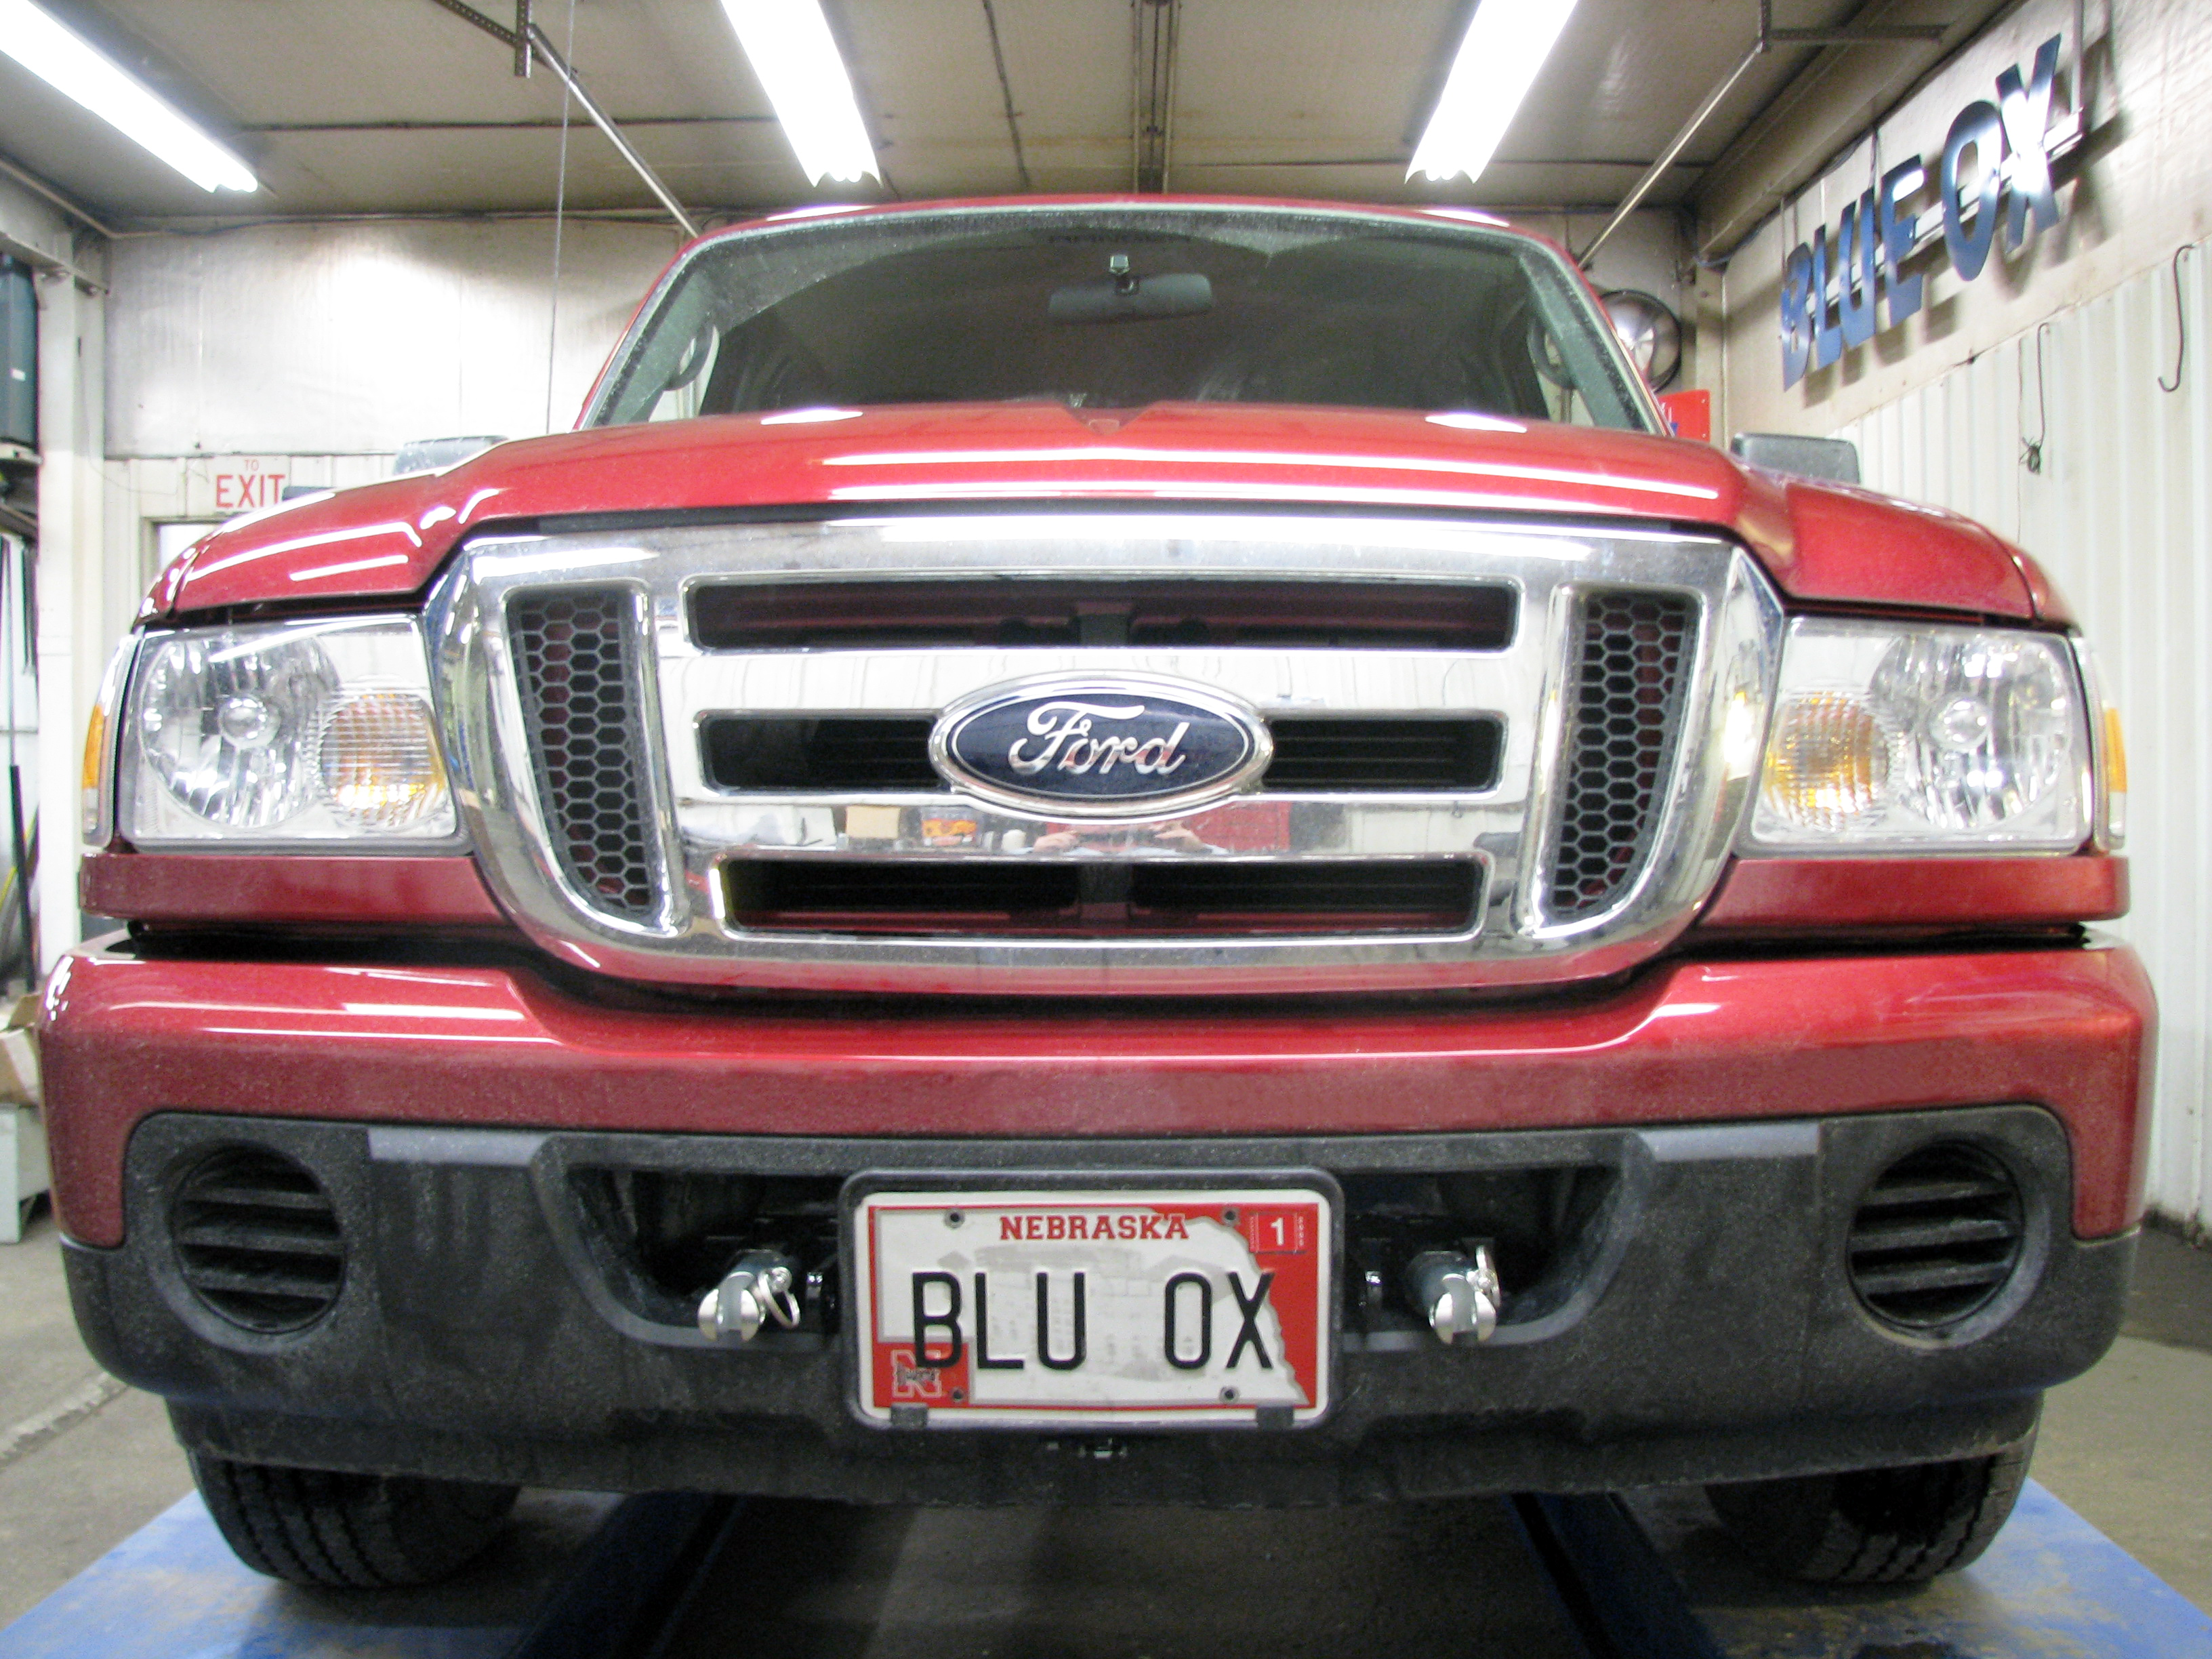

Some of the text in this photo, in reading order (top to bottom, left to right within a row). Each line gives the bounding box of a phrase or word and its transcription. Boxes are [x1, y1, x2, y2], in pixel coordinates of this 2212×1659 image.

[1780, 33, 2062, 392] BLUE OX
[245, 459, 259, 471] TO
[216, 474, 285, 508] EXIT
[1008, 701, 1189, 775] Ford
[1000, 1215, 1189, 1240] NEBRASKA
[1271, 1217, 1284, 1246] 1
[912, 1271, 1275, 1370] BLU OX
